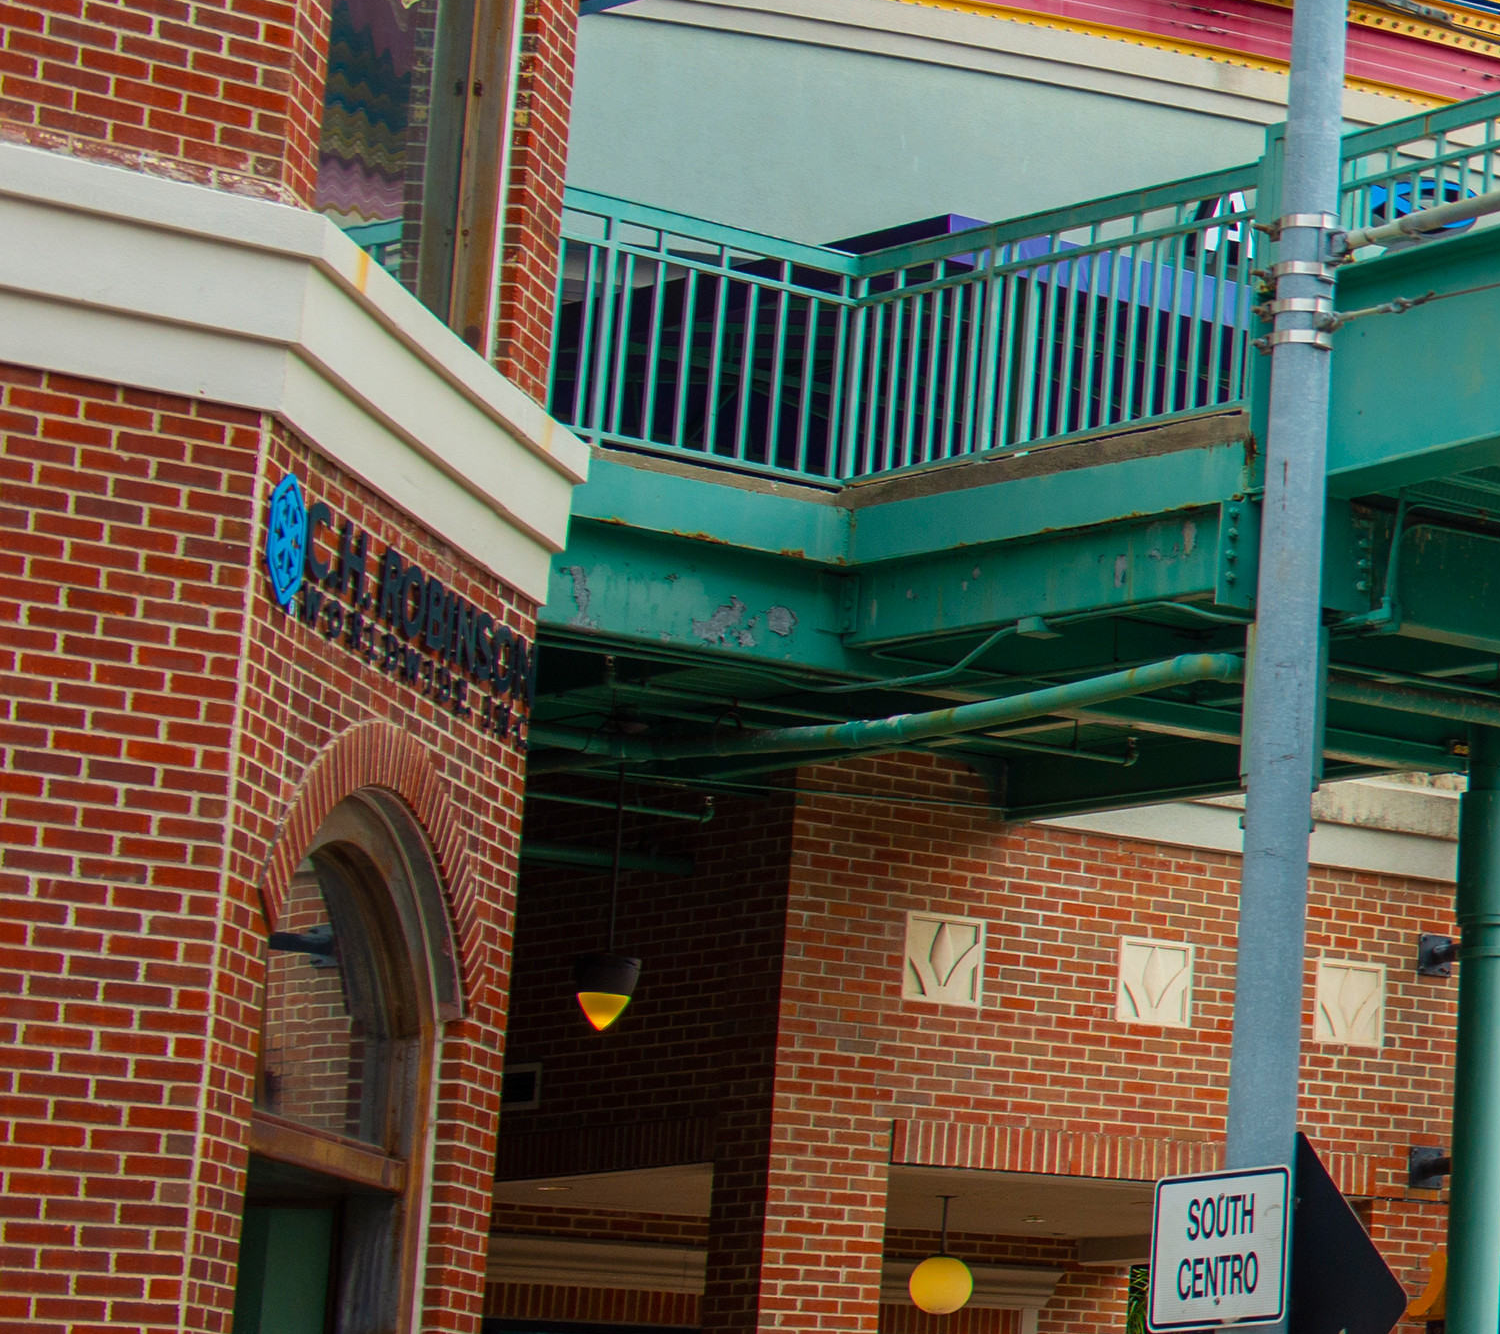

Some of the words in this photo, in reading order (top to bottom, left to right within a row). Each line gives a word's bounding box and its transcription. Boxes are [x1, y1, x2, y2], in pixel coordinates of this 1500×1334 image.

[302, 581, 471, 716] WORLDWIDE
[307, 502, 372, 612] C.H.
[381, 545, 537, 708] ROBINSON
[1186, 1192, 1256, 1242] SOUTH
[1176, 1251, 1259, 1301] CENTRO
